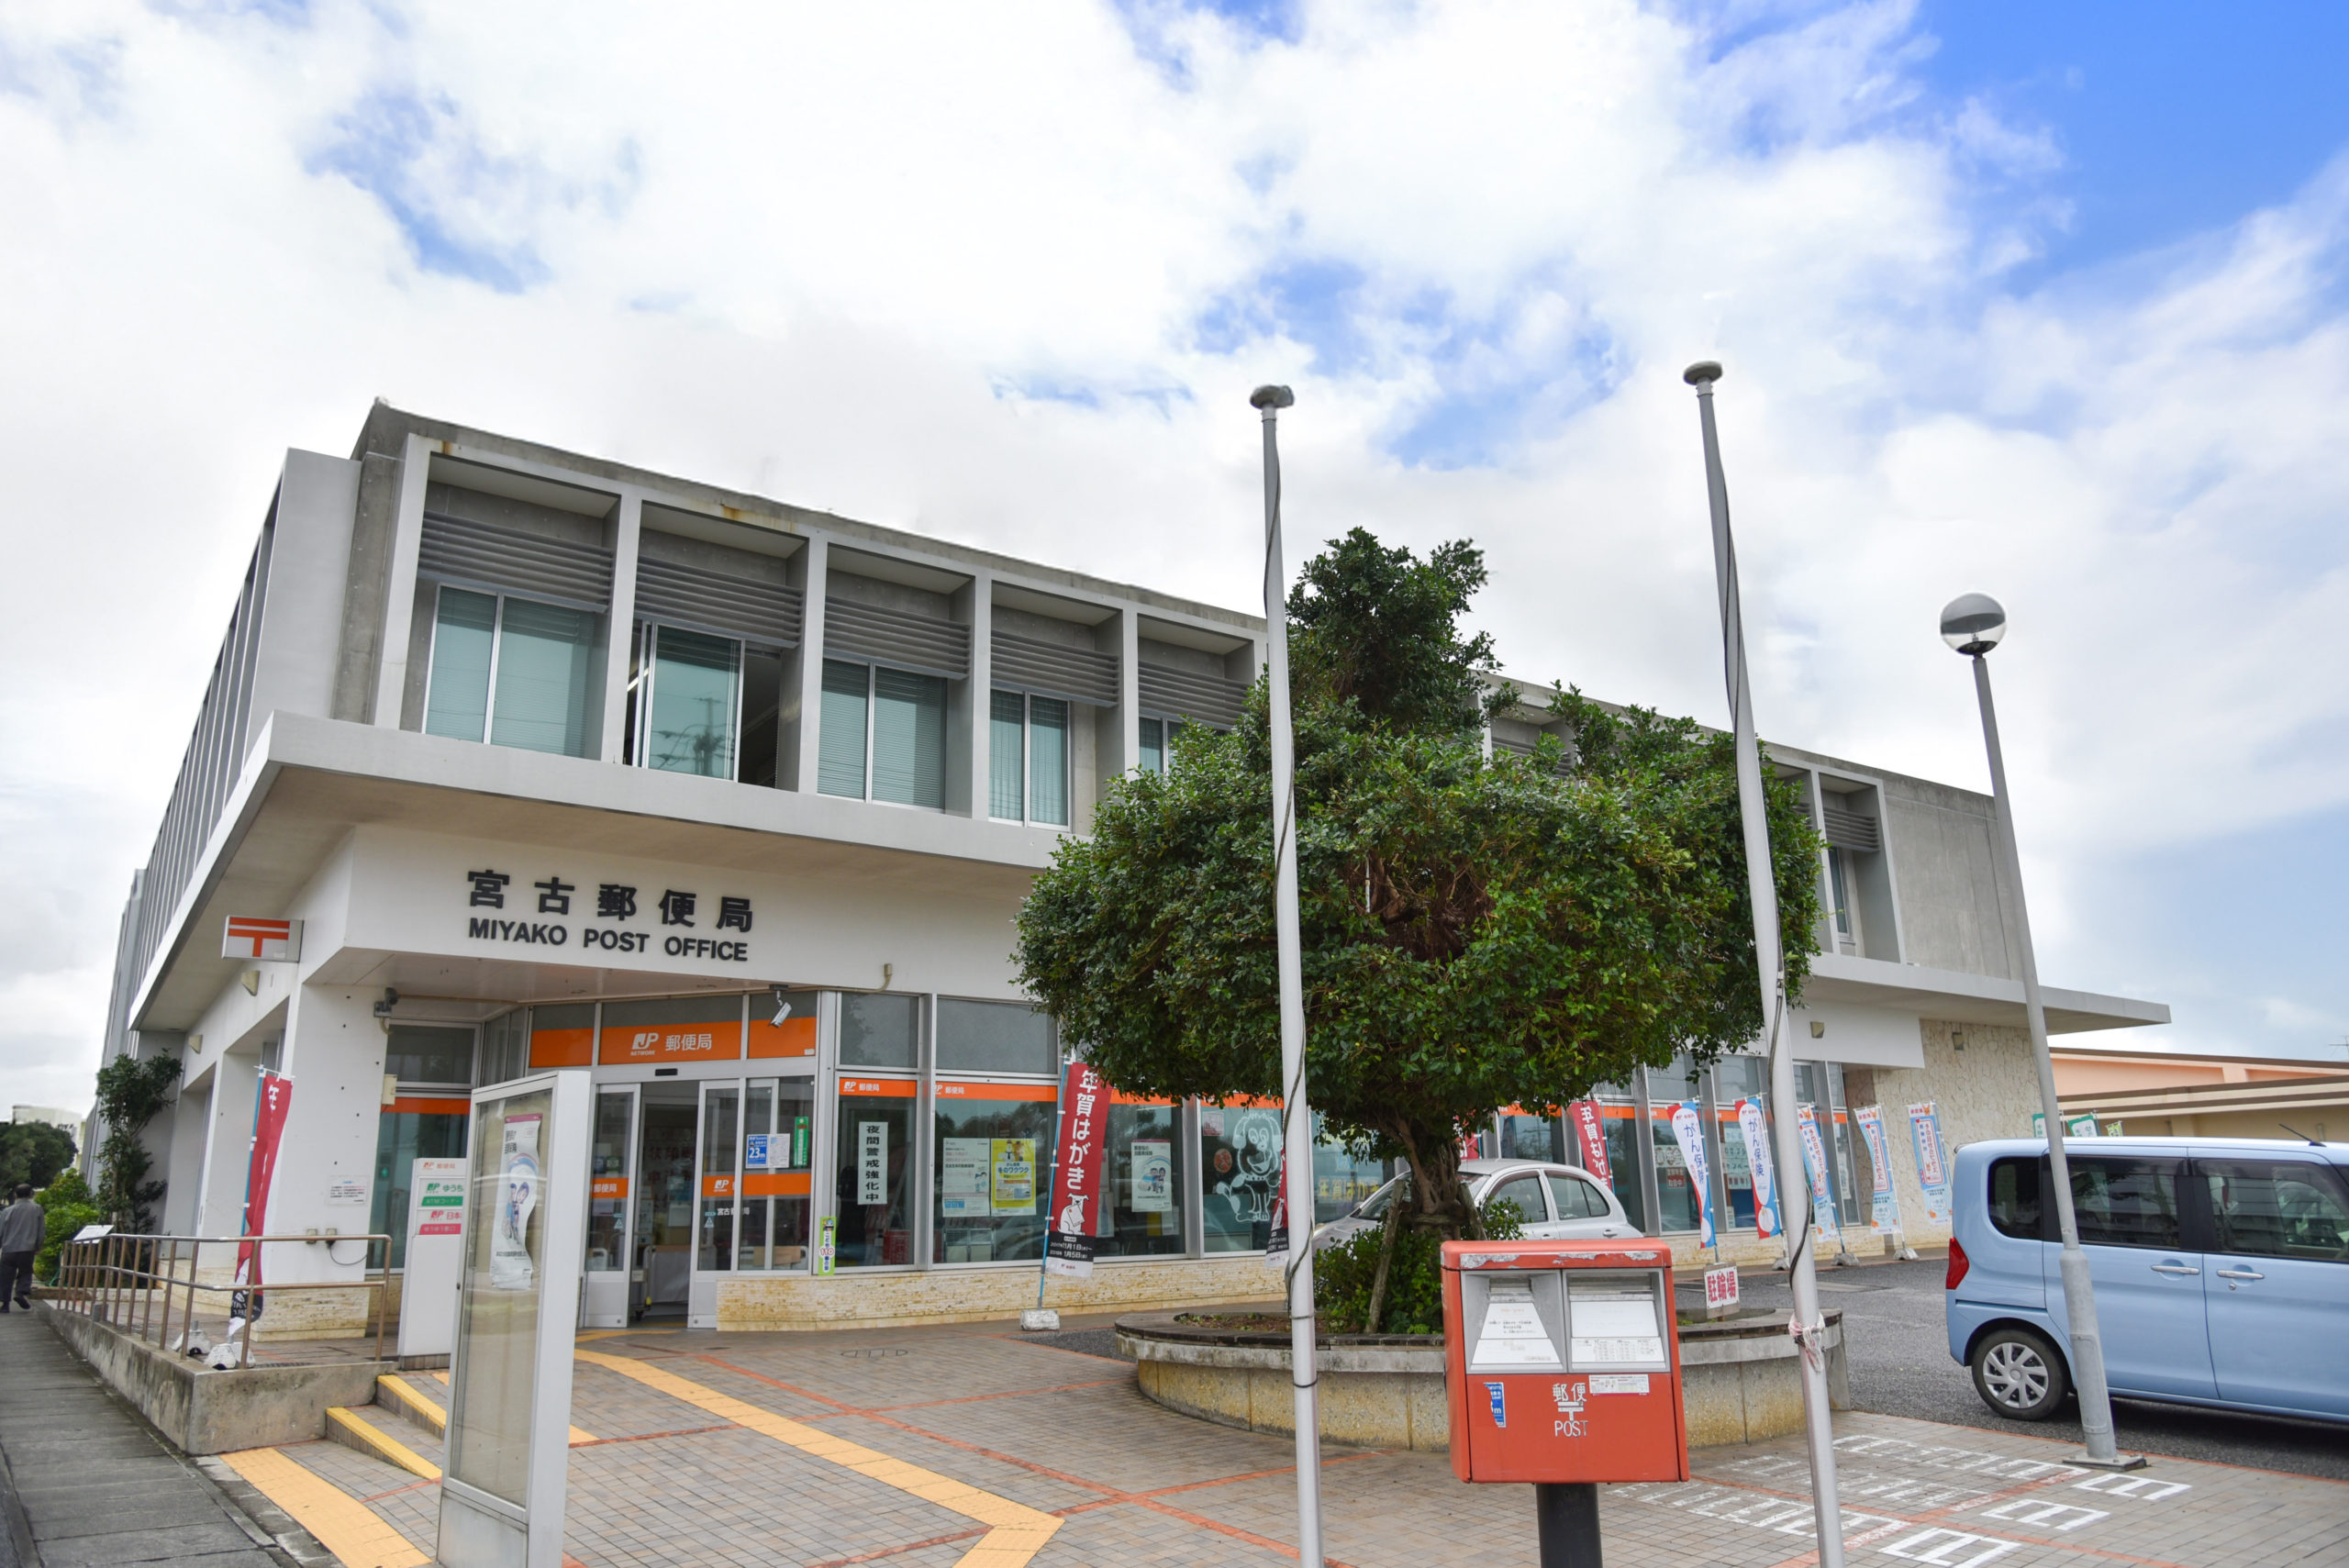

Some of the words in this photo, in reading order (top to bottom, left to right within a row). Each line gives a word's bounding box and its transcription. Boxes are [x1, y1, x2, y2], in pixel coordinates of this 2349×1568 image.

[468, 869, 752, 933] 宮古郵便局
[469, 917, 567, 945] MIYAKO
[584, 929, 650, 952] POST
[664, 936, 748, 962] OFFICE
[665, 1034, 712, 1051] 郵便局
[859, 1083, 879, 1092] 郵便局
[1066, 1070, 1097, 1190] 年賀はがき
[749, 1147, 766, 1159] 23m
[865, 1125, 881, 1202] 夜間警戒強化中
[1707, 1271, 1736, 1303] 駐輪場
[1553, 1383, 1587, 1402] 郵便
[1554, 1419, 1588, 1437] POST
